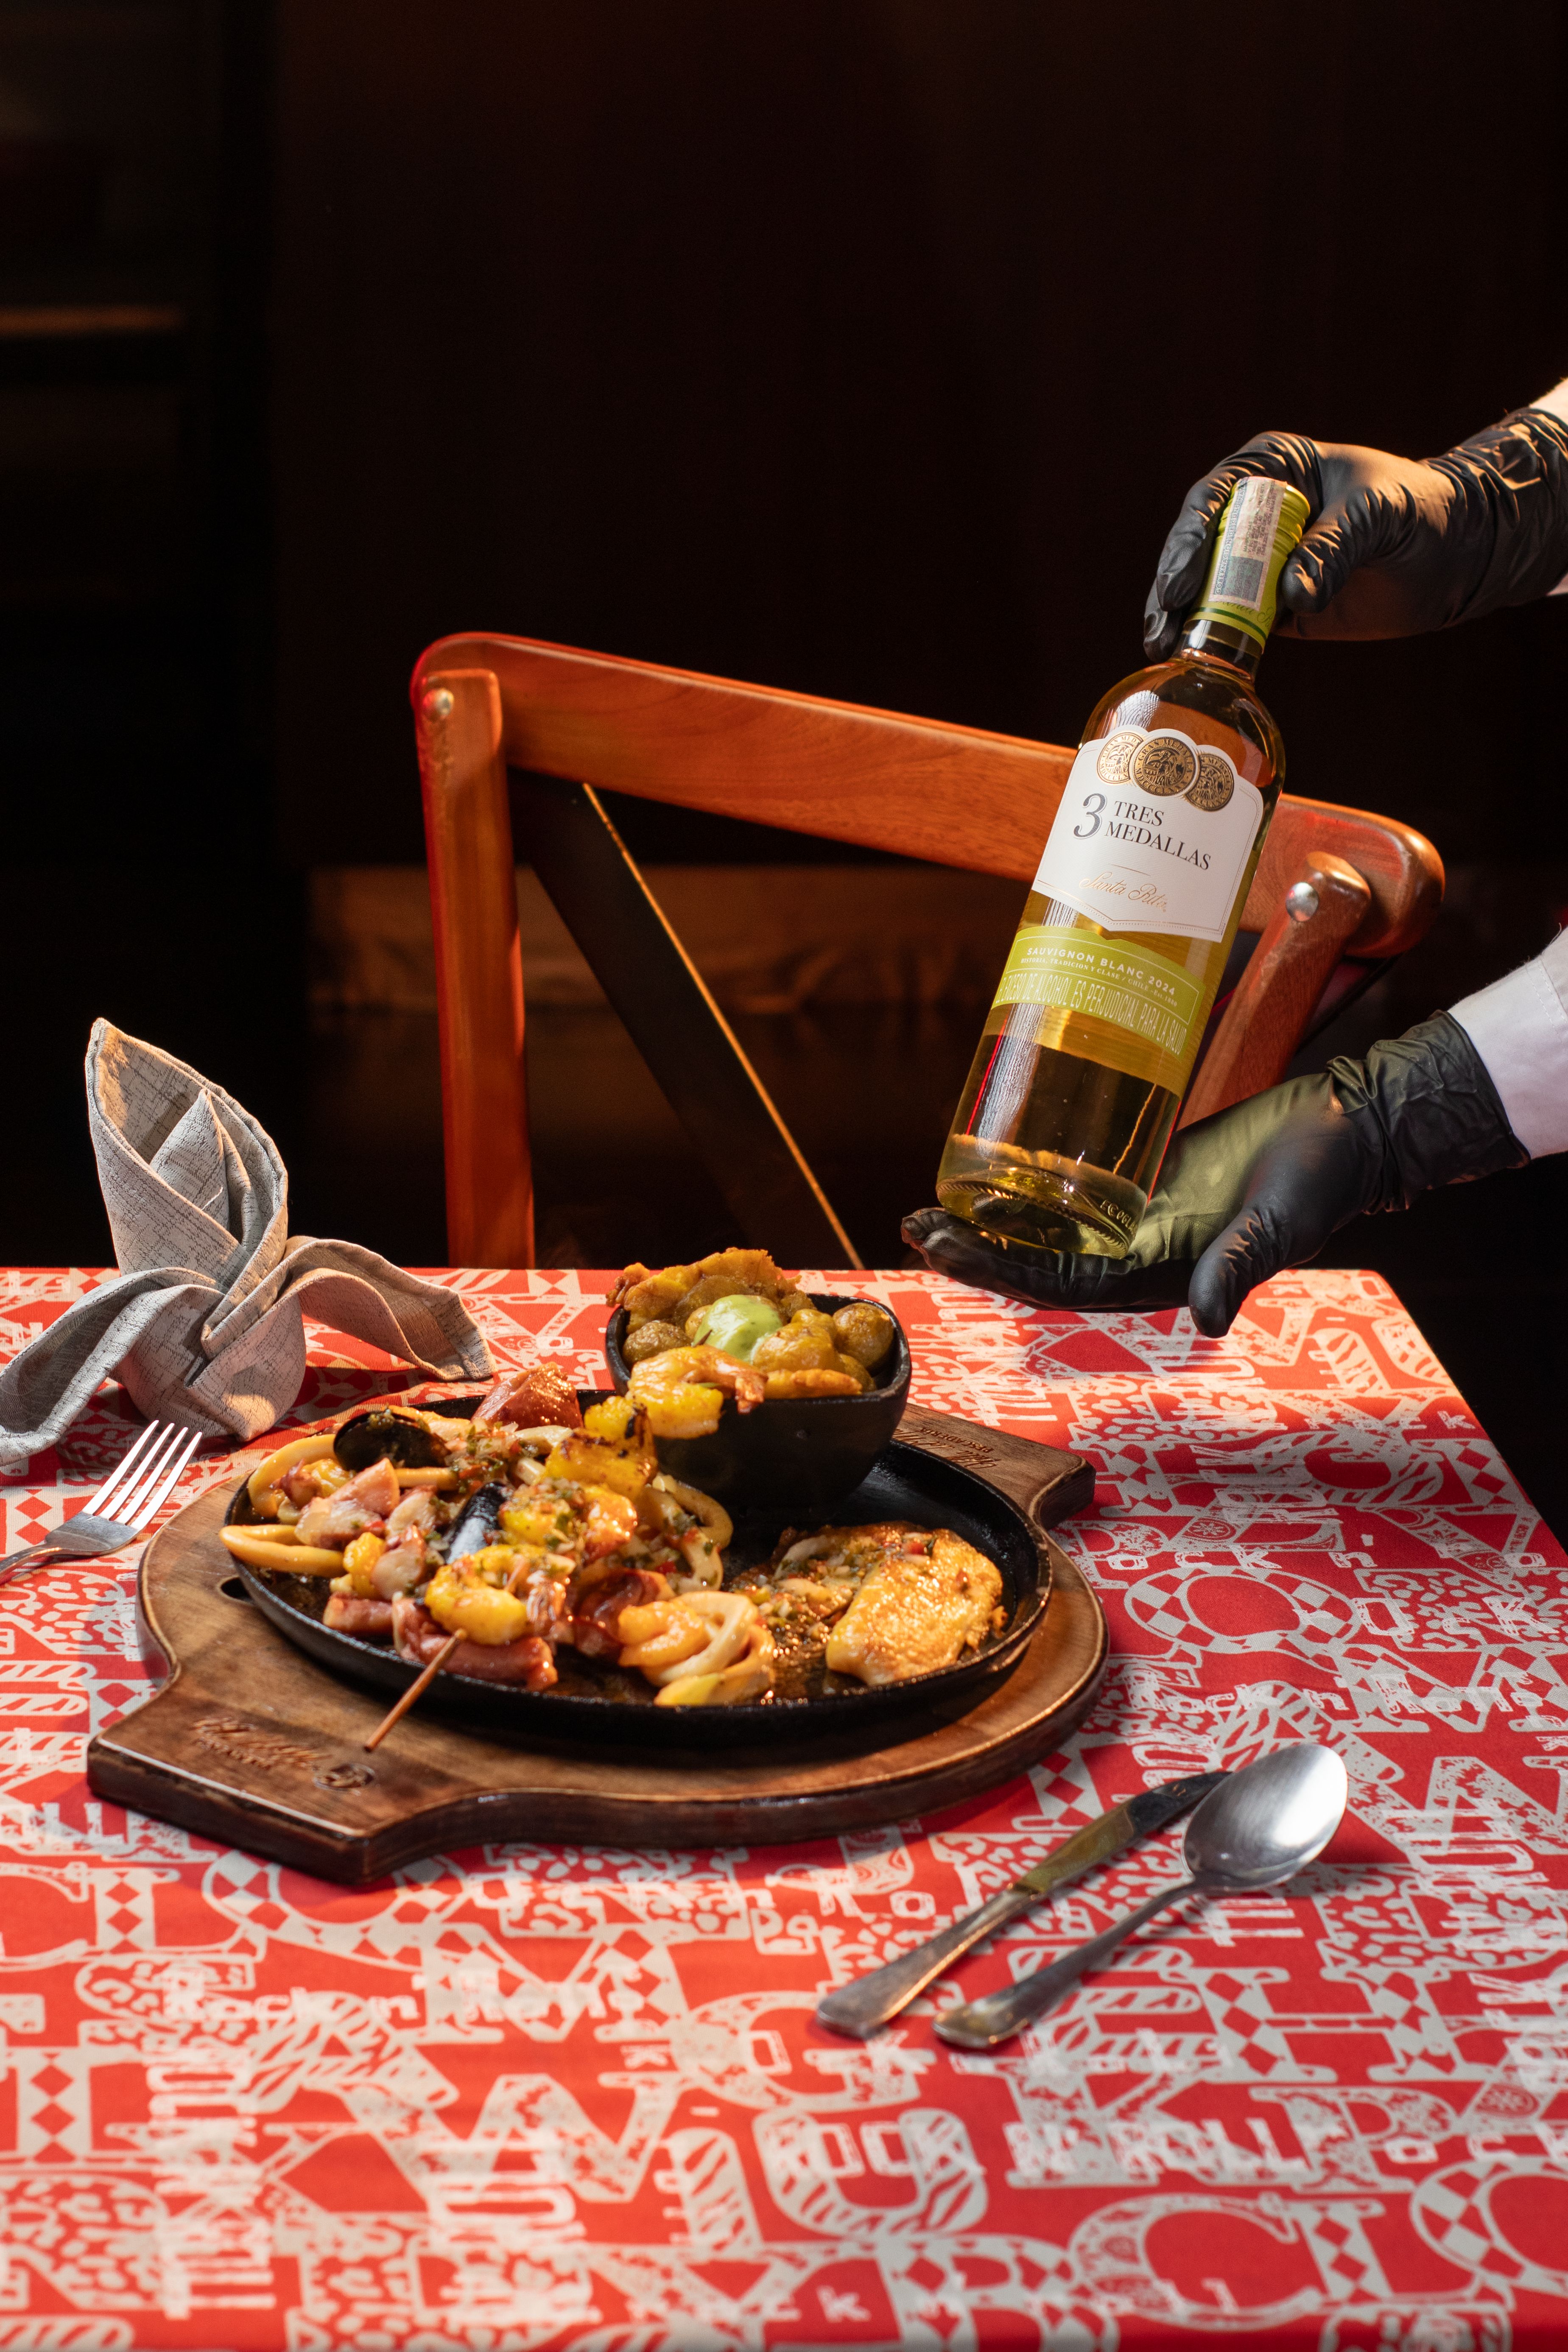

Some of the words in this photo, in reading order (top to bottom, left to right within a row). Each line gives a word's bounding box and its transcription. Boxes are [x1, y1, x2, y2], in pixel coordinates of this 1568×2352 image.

[1138, 740, 1159, 760] GRAN
[1073, 793, 1107, 839] 3
[1114, 801, 1164, 826] TRES
[1104, 821, 1211, 870] MEDALLAS
[1079, 872, 1127, 895] Santa
[1027, 947, 1095, 963] SAUVIGNON
[1100, 958, 1143, 979] BLANC
[1149, 976, 1175, 995] 2024
[1097, 969, 1120, 979] CLASE
[1128, 978, 1149, 991] CHILE
[1022, 973, 1038, 1000] DE
[1033, 973, 1073, 1006] ALCOHOL
[1070, 980, 1087, 1008] ES
[1083, 983, 1139, 1027] PERJUDICIAL
[1137, 1003, 1160, 1038] PARA
[1156, 1014, 1169, 1044] LA
[1166, 1019, 1187, 1055] SALUD
[920, 1426, 995, 1453] PESCADERÍA
